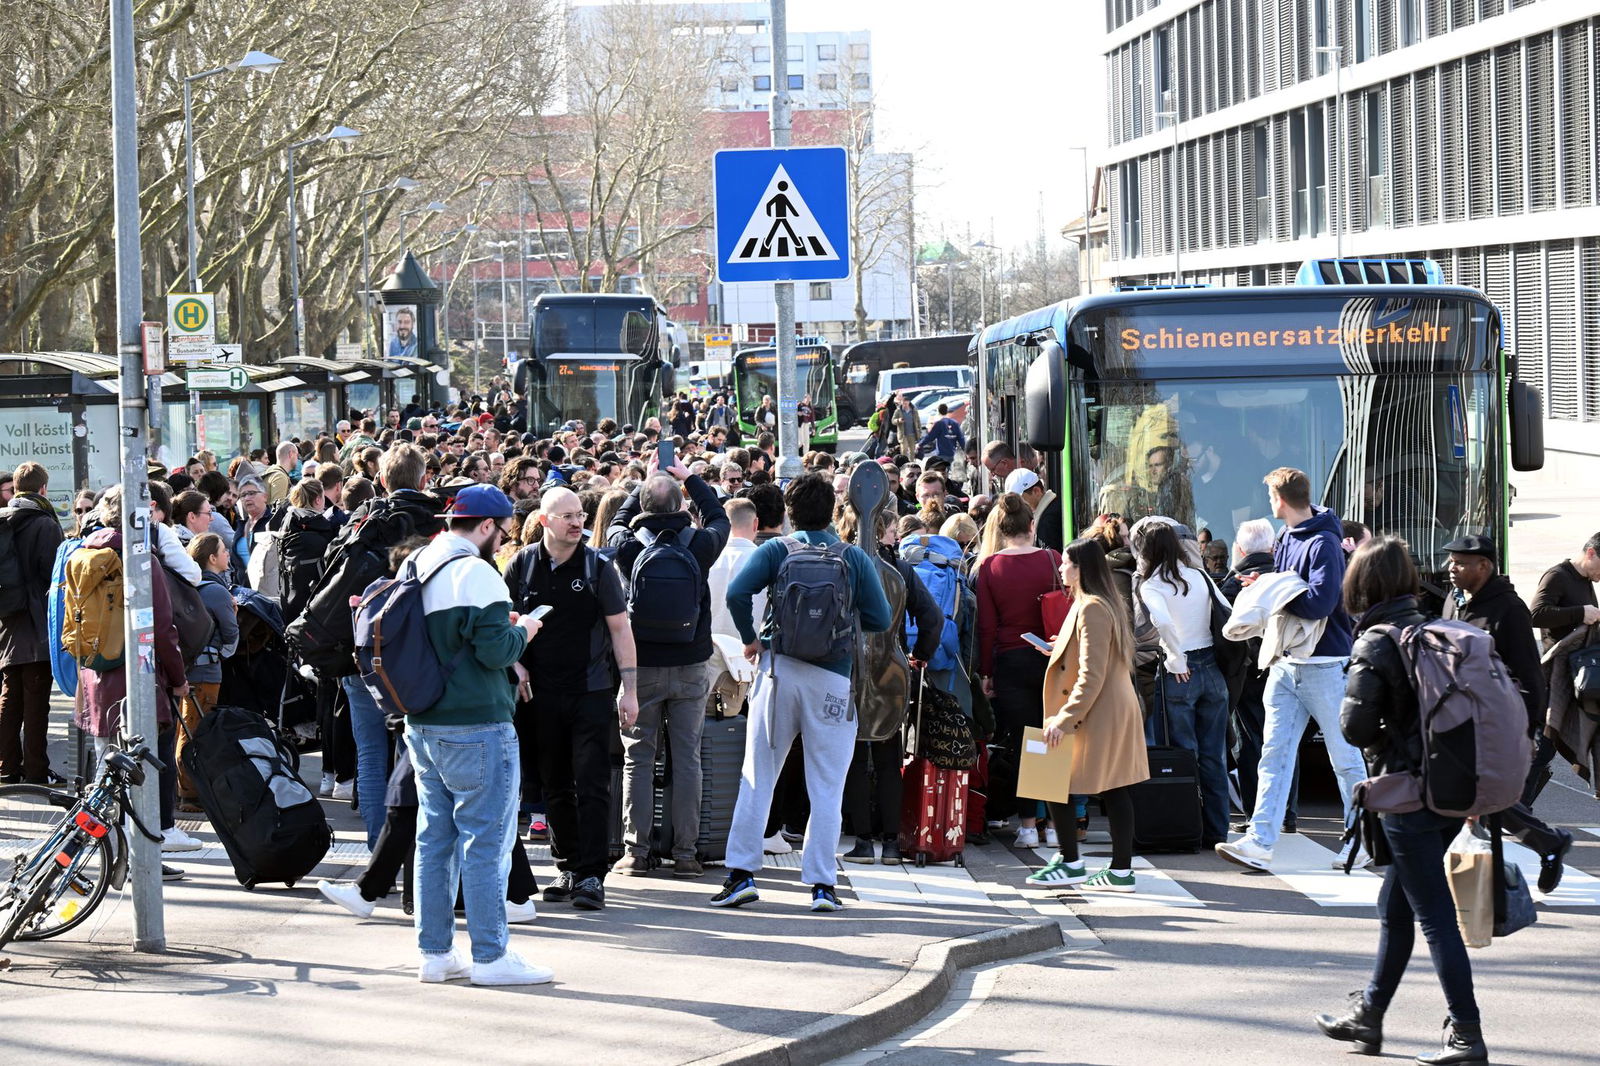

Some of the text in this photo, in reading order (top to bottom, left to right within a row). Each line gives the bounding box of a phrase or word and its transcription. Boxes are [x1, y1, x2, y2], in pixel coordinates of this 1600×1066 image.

[183, 306, 199, 324] H
[1120, 321, 1450, 350] Schienenersatzverkehr
[230, 371, 243, 387] H
[5, 423, 31, 437] Voll
[0, 439, 100, 457] Null künsth.
